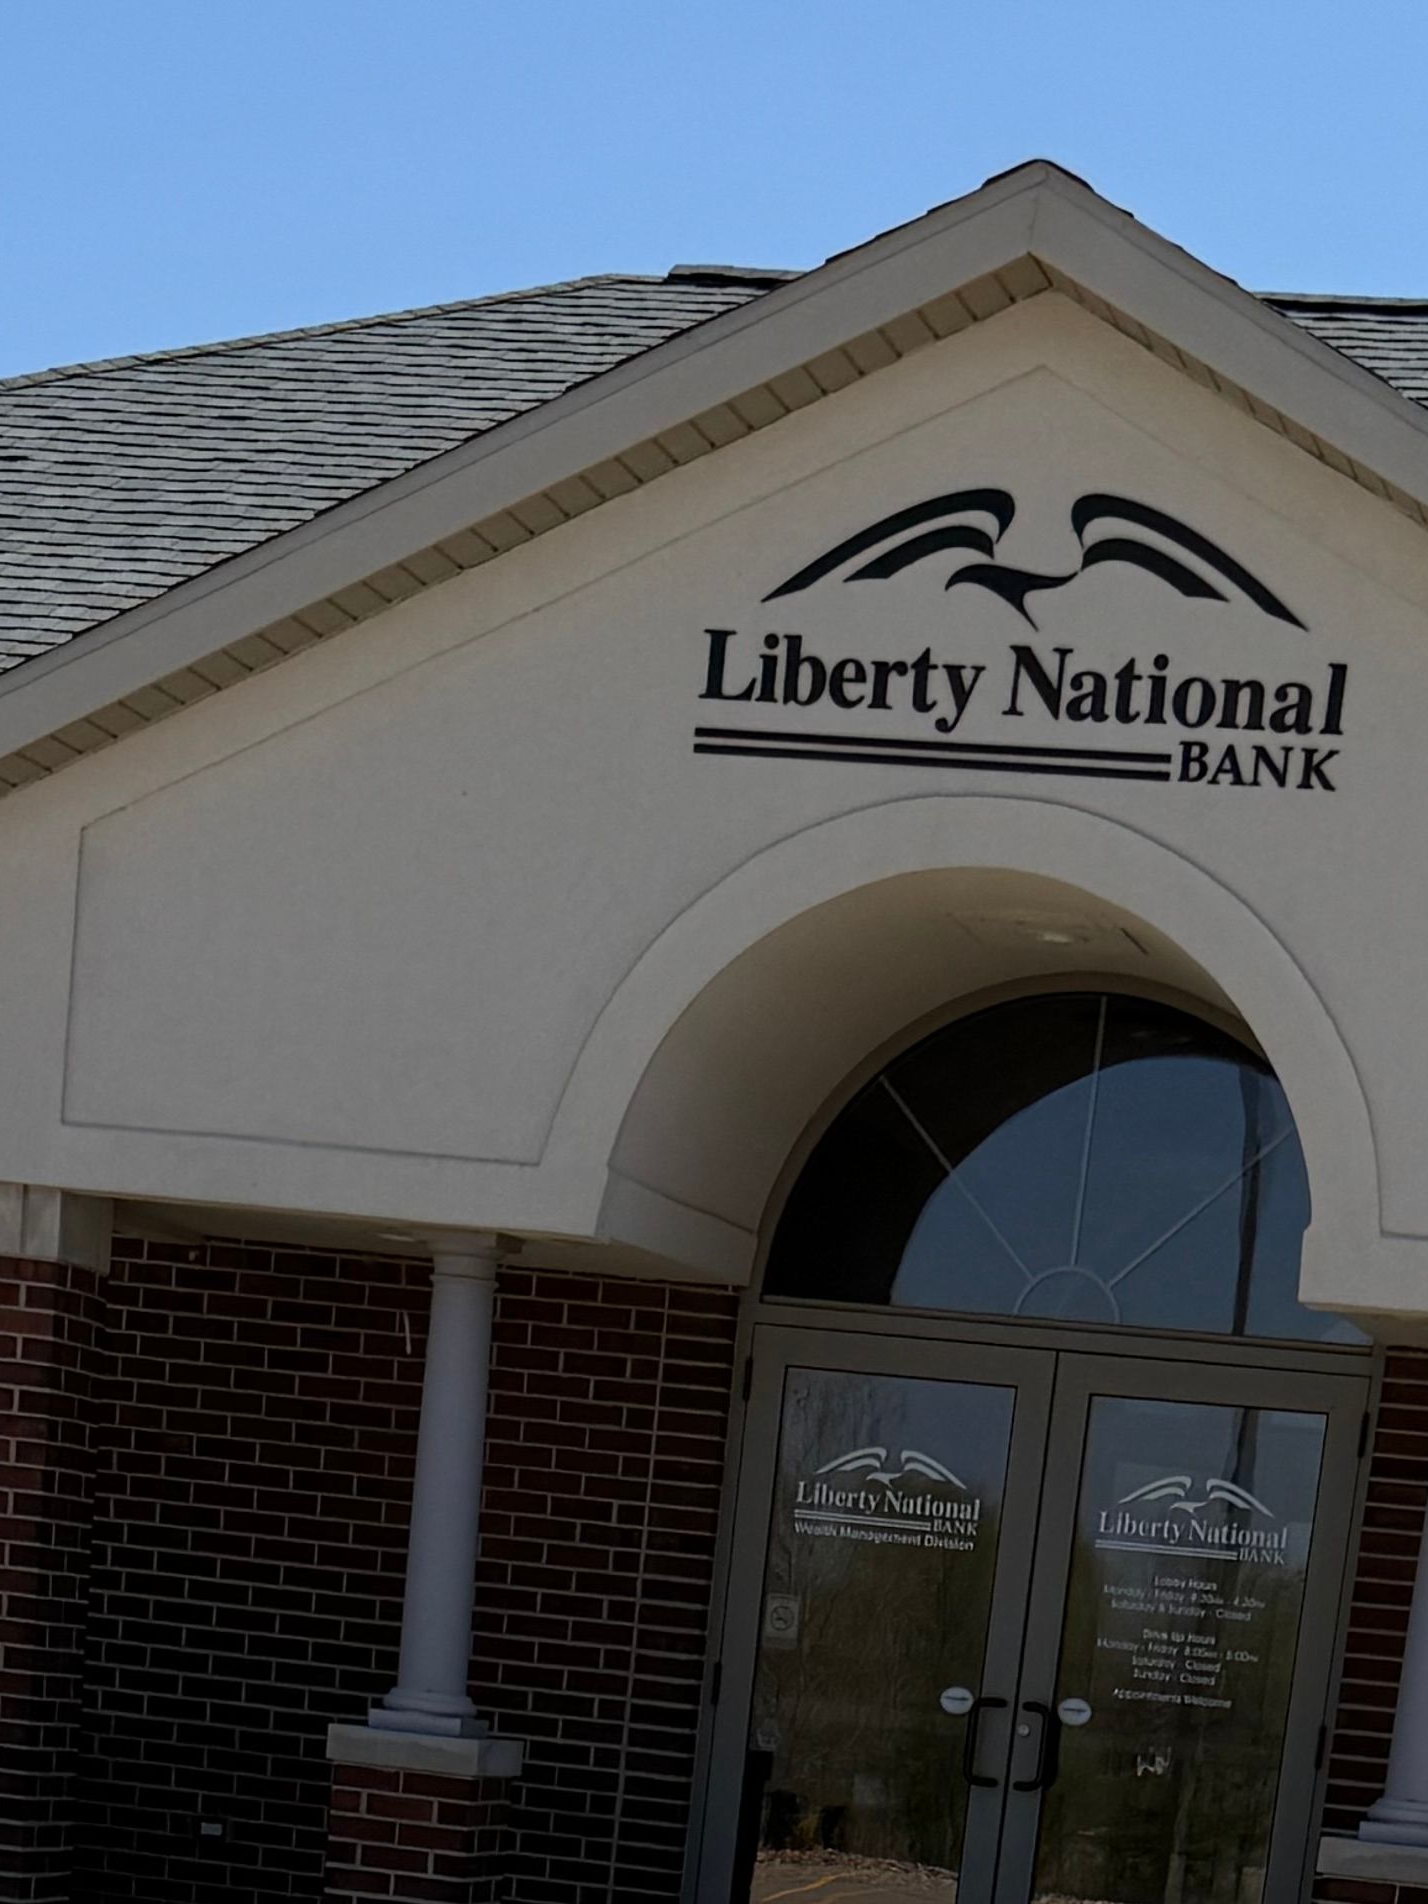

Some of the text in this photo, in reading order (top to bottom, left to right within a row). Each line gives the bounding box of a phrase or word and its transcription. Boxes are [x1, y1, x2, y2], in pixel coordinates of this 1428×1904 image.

[698, 628, 1349, 736] Liberty National
[1177, 741, 1341, 792] BANK
[795, 1480, 981, 1521] Liberty National
[839, 1525, 921, 1546] Management
[924, 1534, 974, 1551] Division
[933, 1519, 978, 1536] BANK
[1099, 1510, 1288, 1549] Liberty National
[1239, 1548, 1285, 1565] BANK
